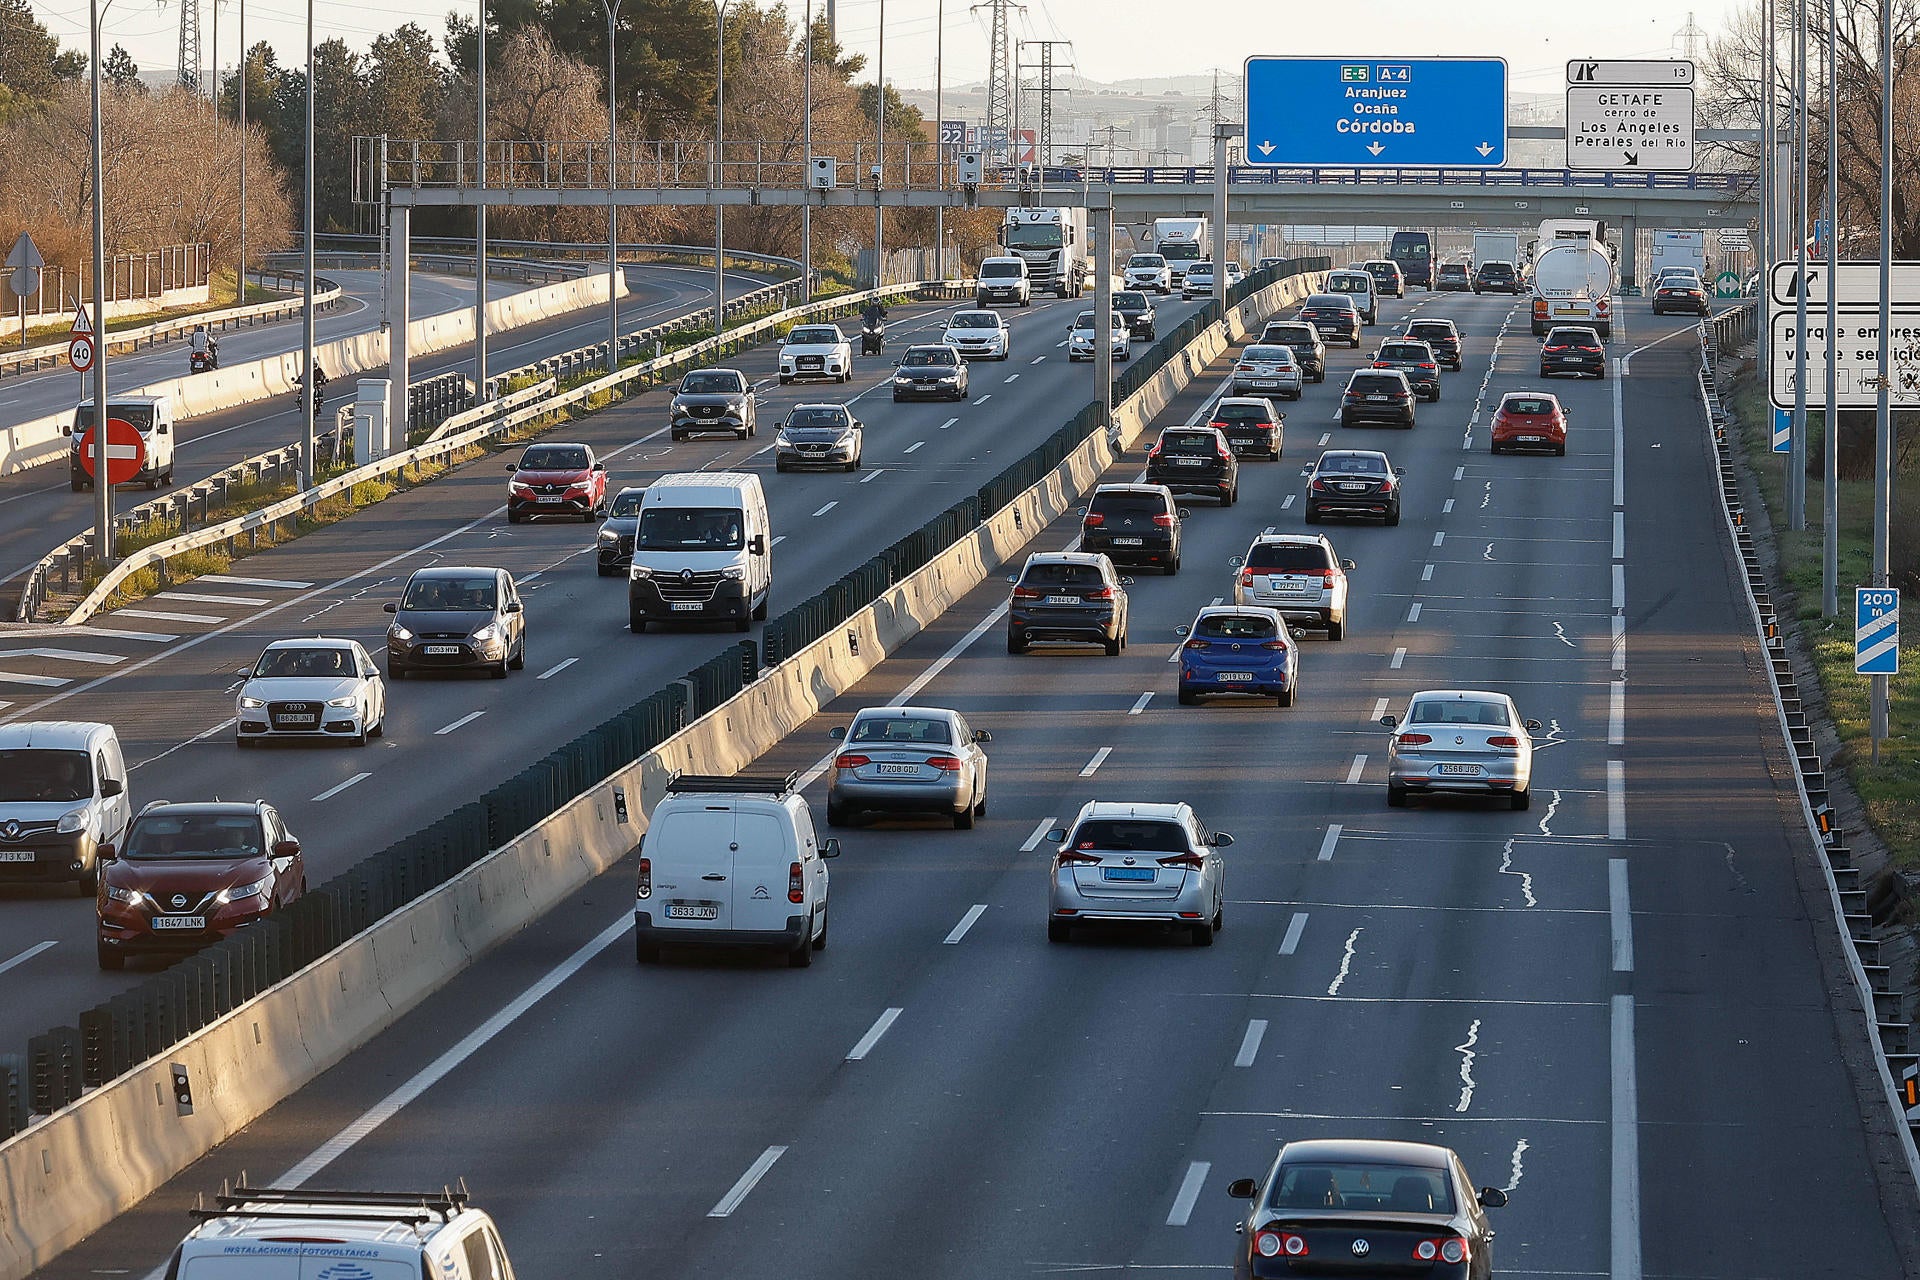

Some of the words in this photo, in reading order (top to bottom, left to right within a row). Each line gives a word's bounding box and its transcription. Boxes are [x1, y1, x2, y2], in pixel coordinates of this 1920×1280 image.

[1343, 68, 1367, 80] E-5
[1380, 68, 1408, 80] A-4
[1673, 68, 1687, 78] 13
[1344, 86, 1407, 100] Aranjuez
[1598, 94, 1663, 106] GETAFE
[1353, 102, 1398, 114] Ocaña
[1604, 109, 1636, 117] cerro
[1643, 108, 1657, 117] de
[1336, 118, 1416, 133] Córdoba
[1581, 121, 1607, 133] Los
[1616, 119, 1680, 136] Ángeles
[942, 129, 962, 144] 22
[1575, 135, 1633, 147] Perales
[1641, 138, 1659, 148] del
[1785, 327, 1845, 341] prqe
[73, 347, 89, 360] 40
[1863, 593, 1893, 606] 200
[1871, 607, 1884, 617] m
[881, 764, 902, 773] 7208
[1444, 765, 1463, 773] 2566
[1465, 765, 1479, 774] JGS
[1824, 834, 1830, 842] 2
[671, 907, 695, 916] 3633
[697, 907, 716, 917] JXN
[160, 918, 182, 928] 1647
[184, 917, 203, 927] LNK
[223, 1246, 300, 1256] INSTALACIONES
[301, 1246, 379, 1258] FOTOVOLTAICAS
